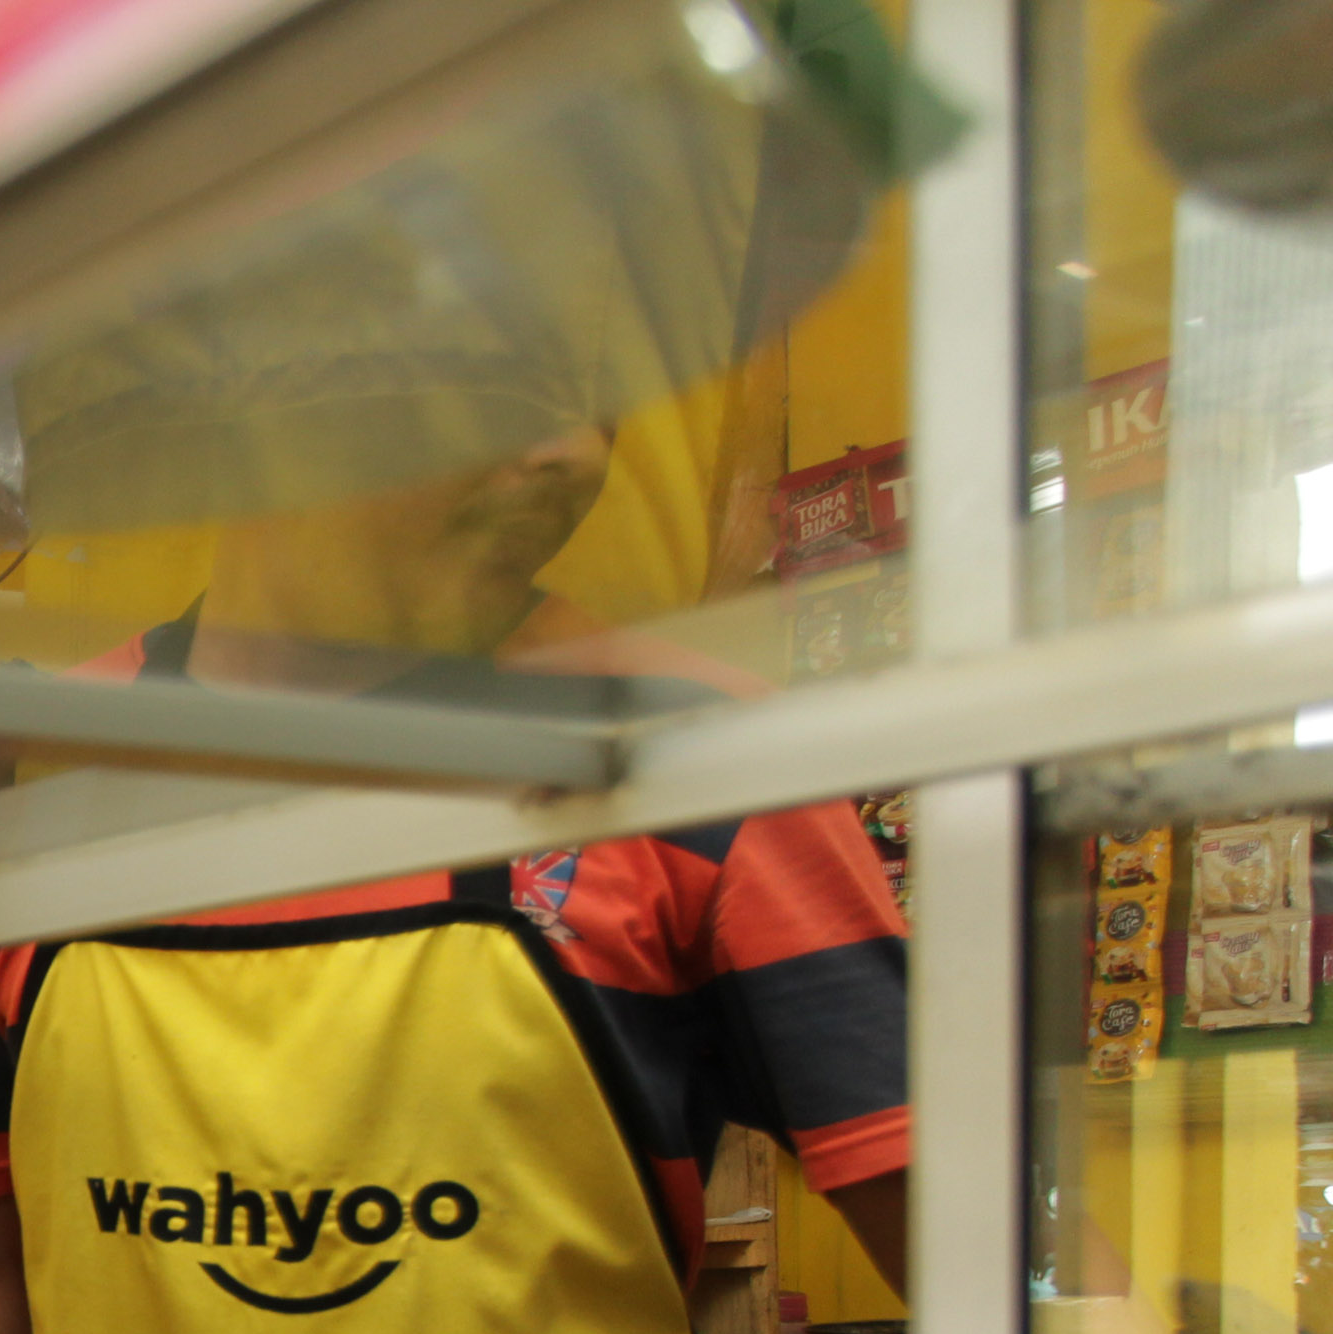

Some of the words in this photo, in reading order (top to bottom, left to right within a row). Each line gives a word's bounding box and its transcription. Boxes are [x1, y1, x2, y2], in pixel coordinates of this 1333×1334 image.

[795, 492, 847, 523] TORA
[801, 508, 847, 541] BIKA
[1102, 1016, 1134, 1033] Cafe
[1106, 1003, 1134, 1019] Tora
[87, 1172, 479, 1263] wahyoo
